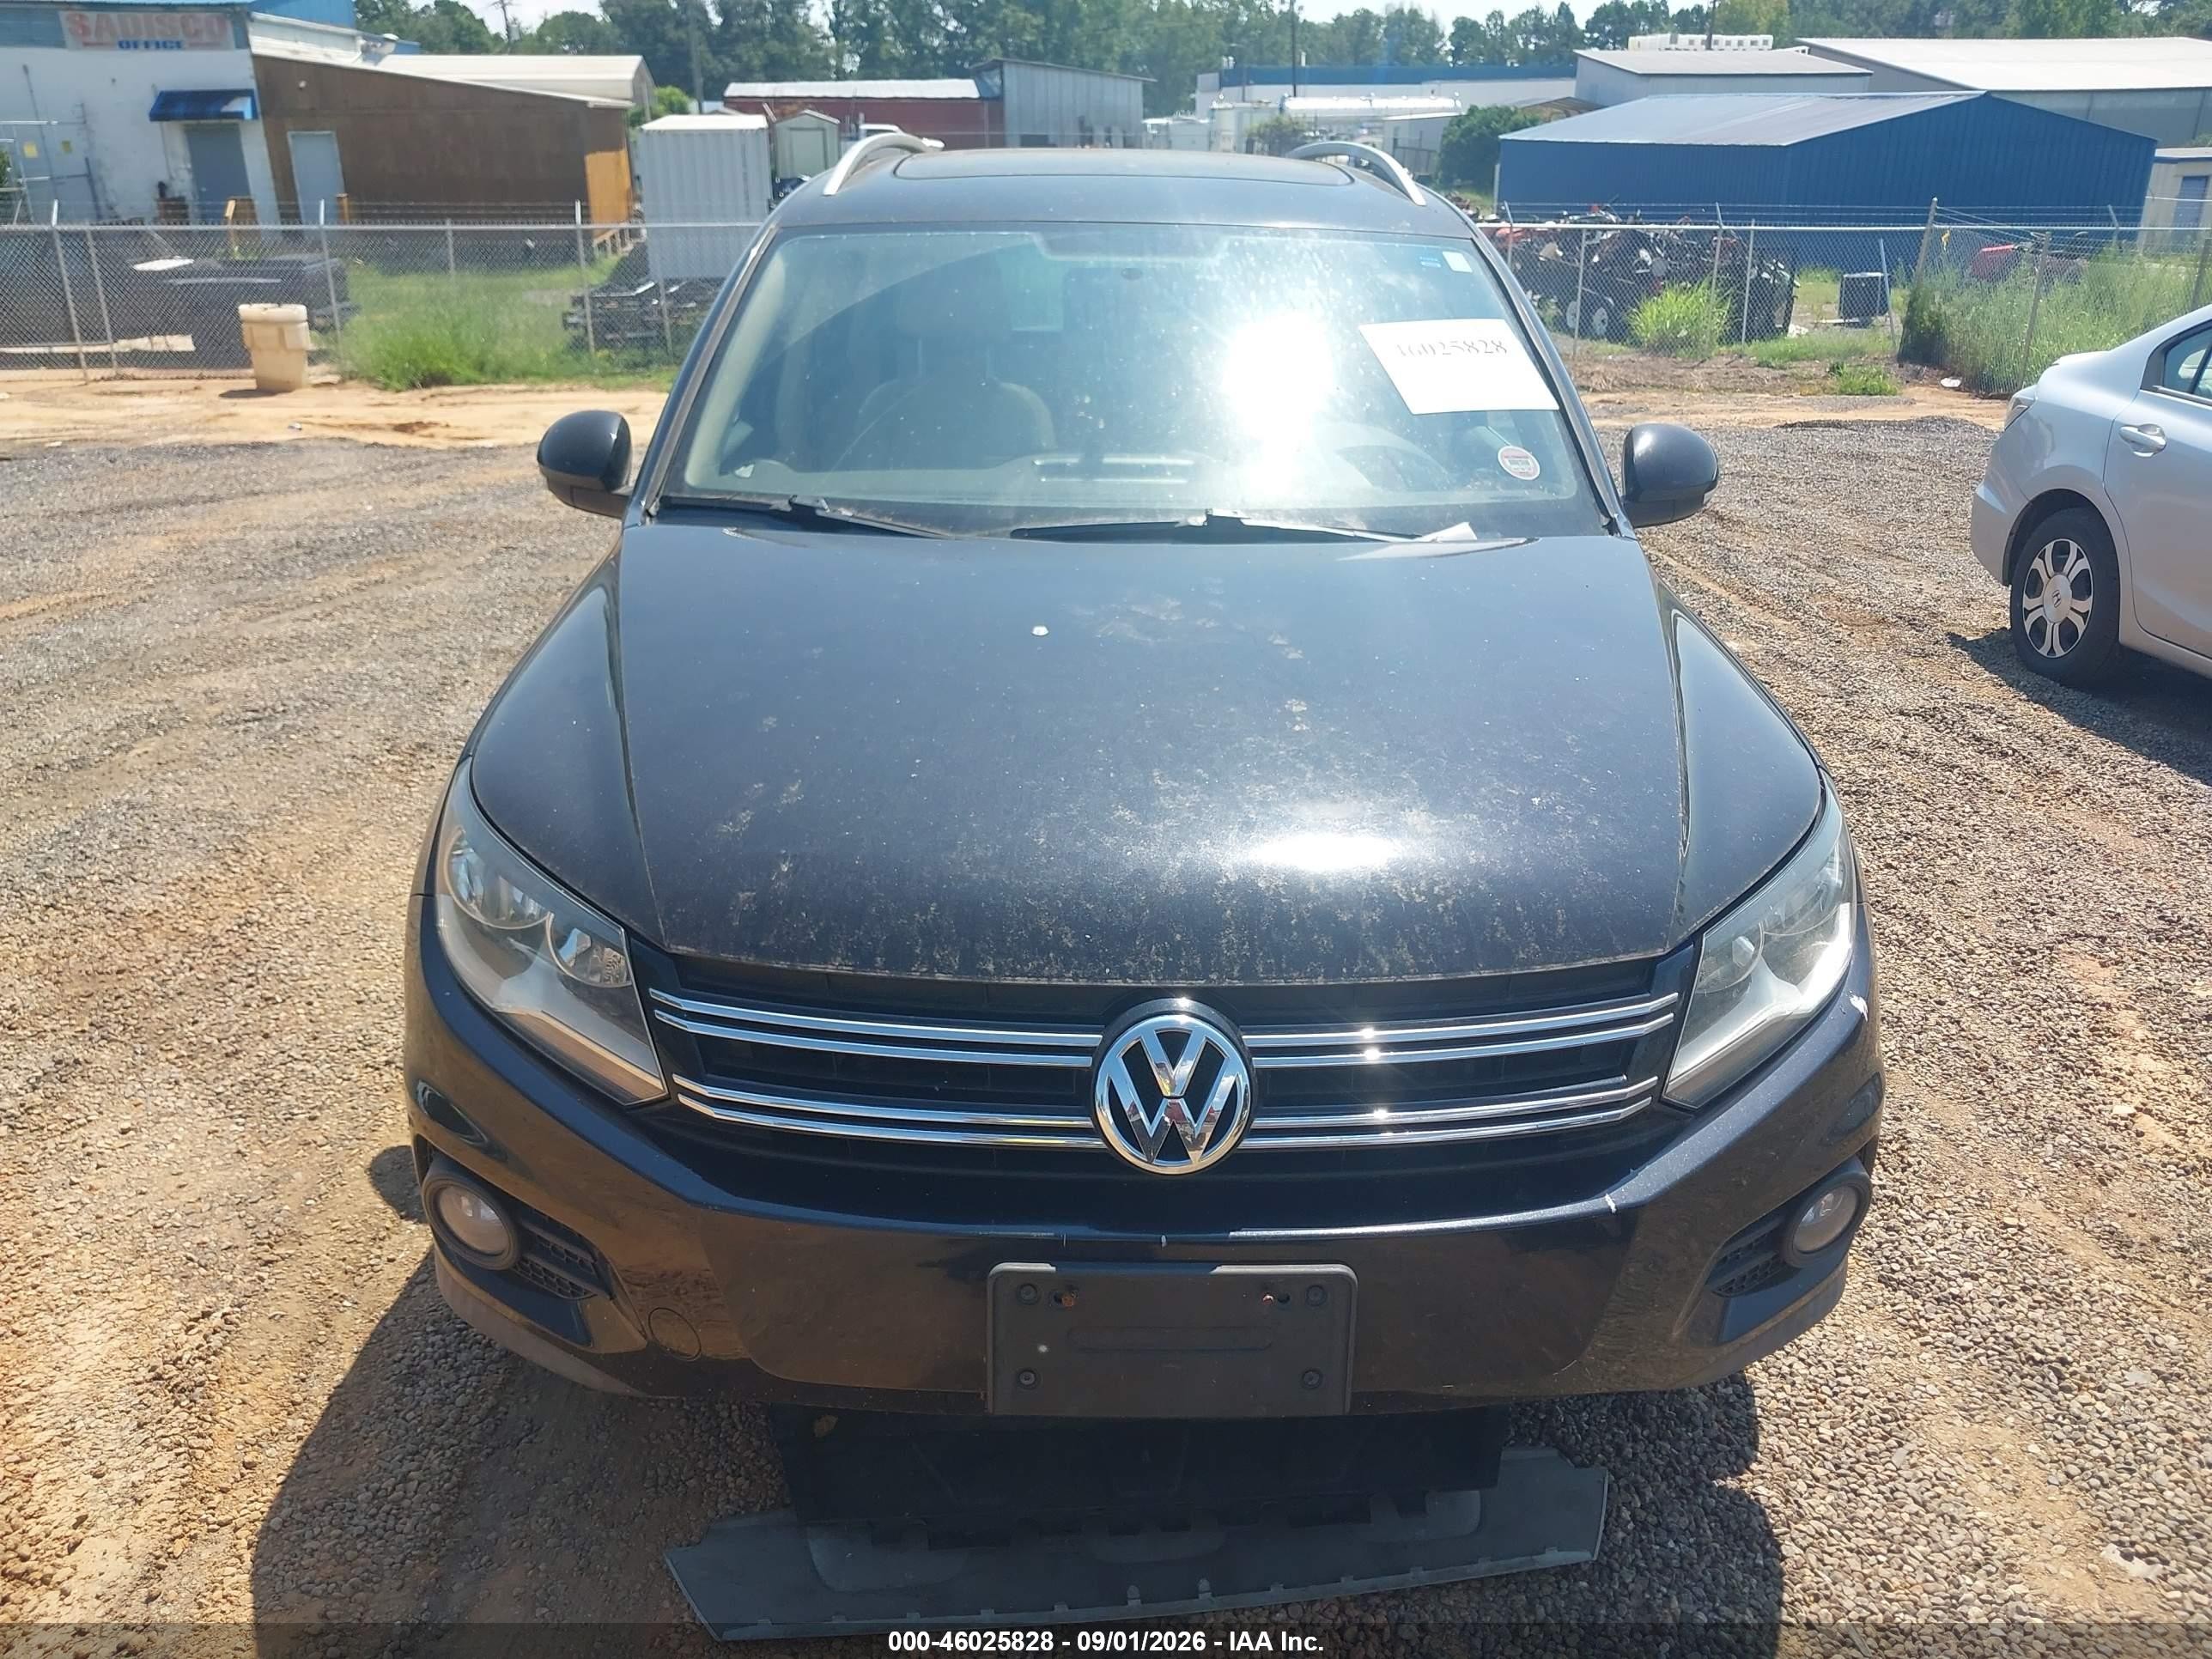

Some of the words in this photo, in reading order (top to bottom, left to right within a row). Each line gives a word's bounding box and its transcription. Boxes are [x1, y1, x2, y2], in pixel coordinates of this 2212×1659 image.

[67, 13, 228, 40] SADISCO
[118, 40, 184, 51] OFFICE
[1098, 1018, 1249, 1171] VW
